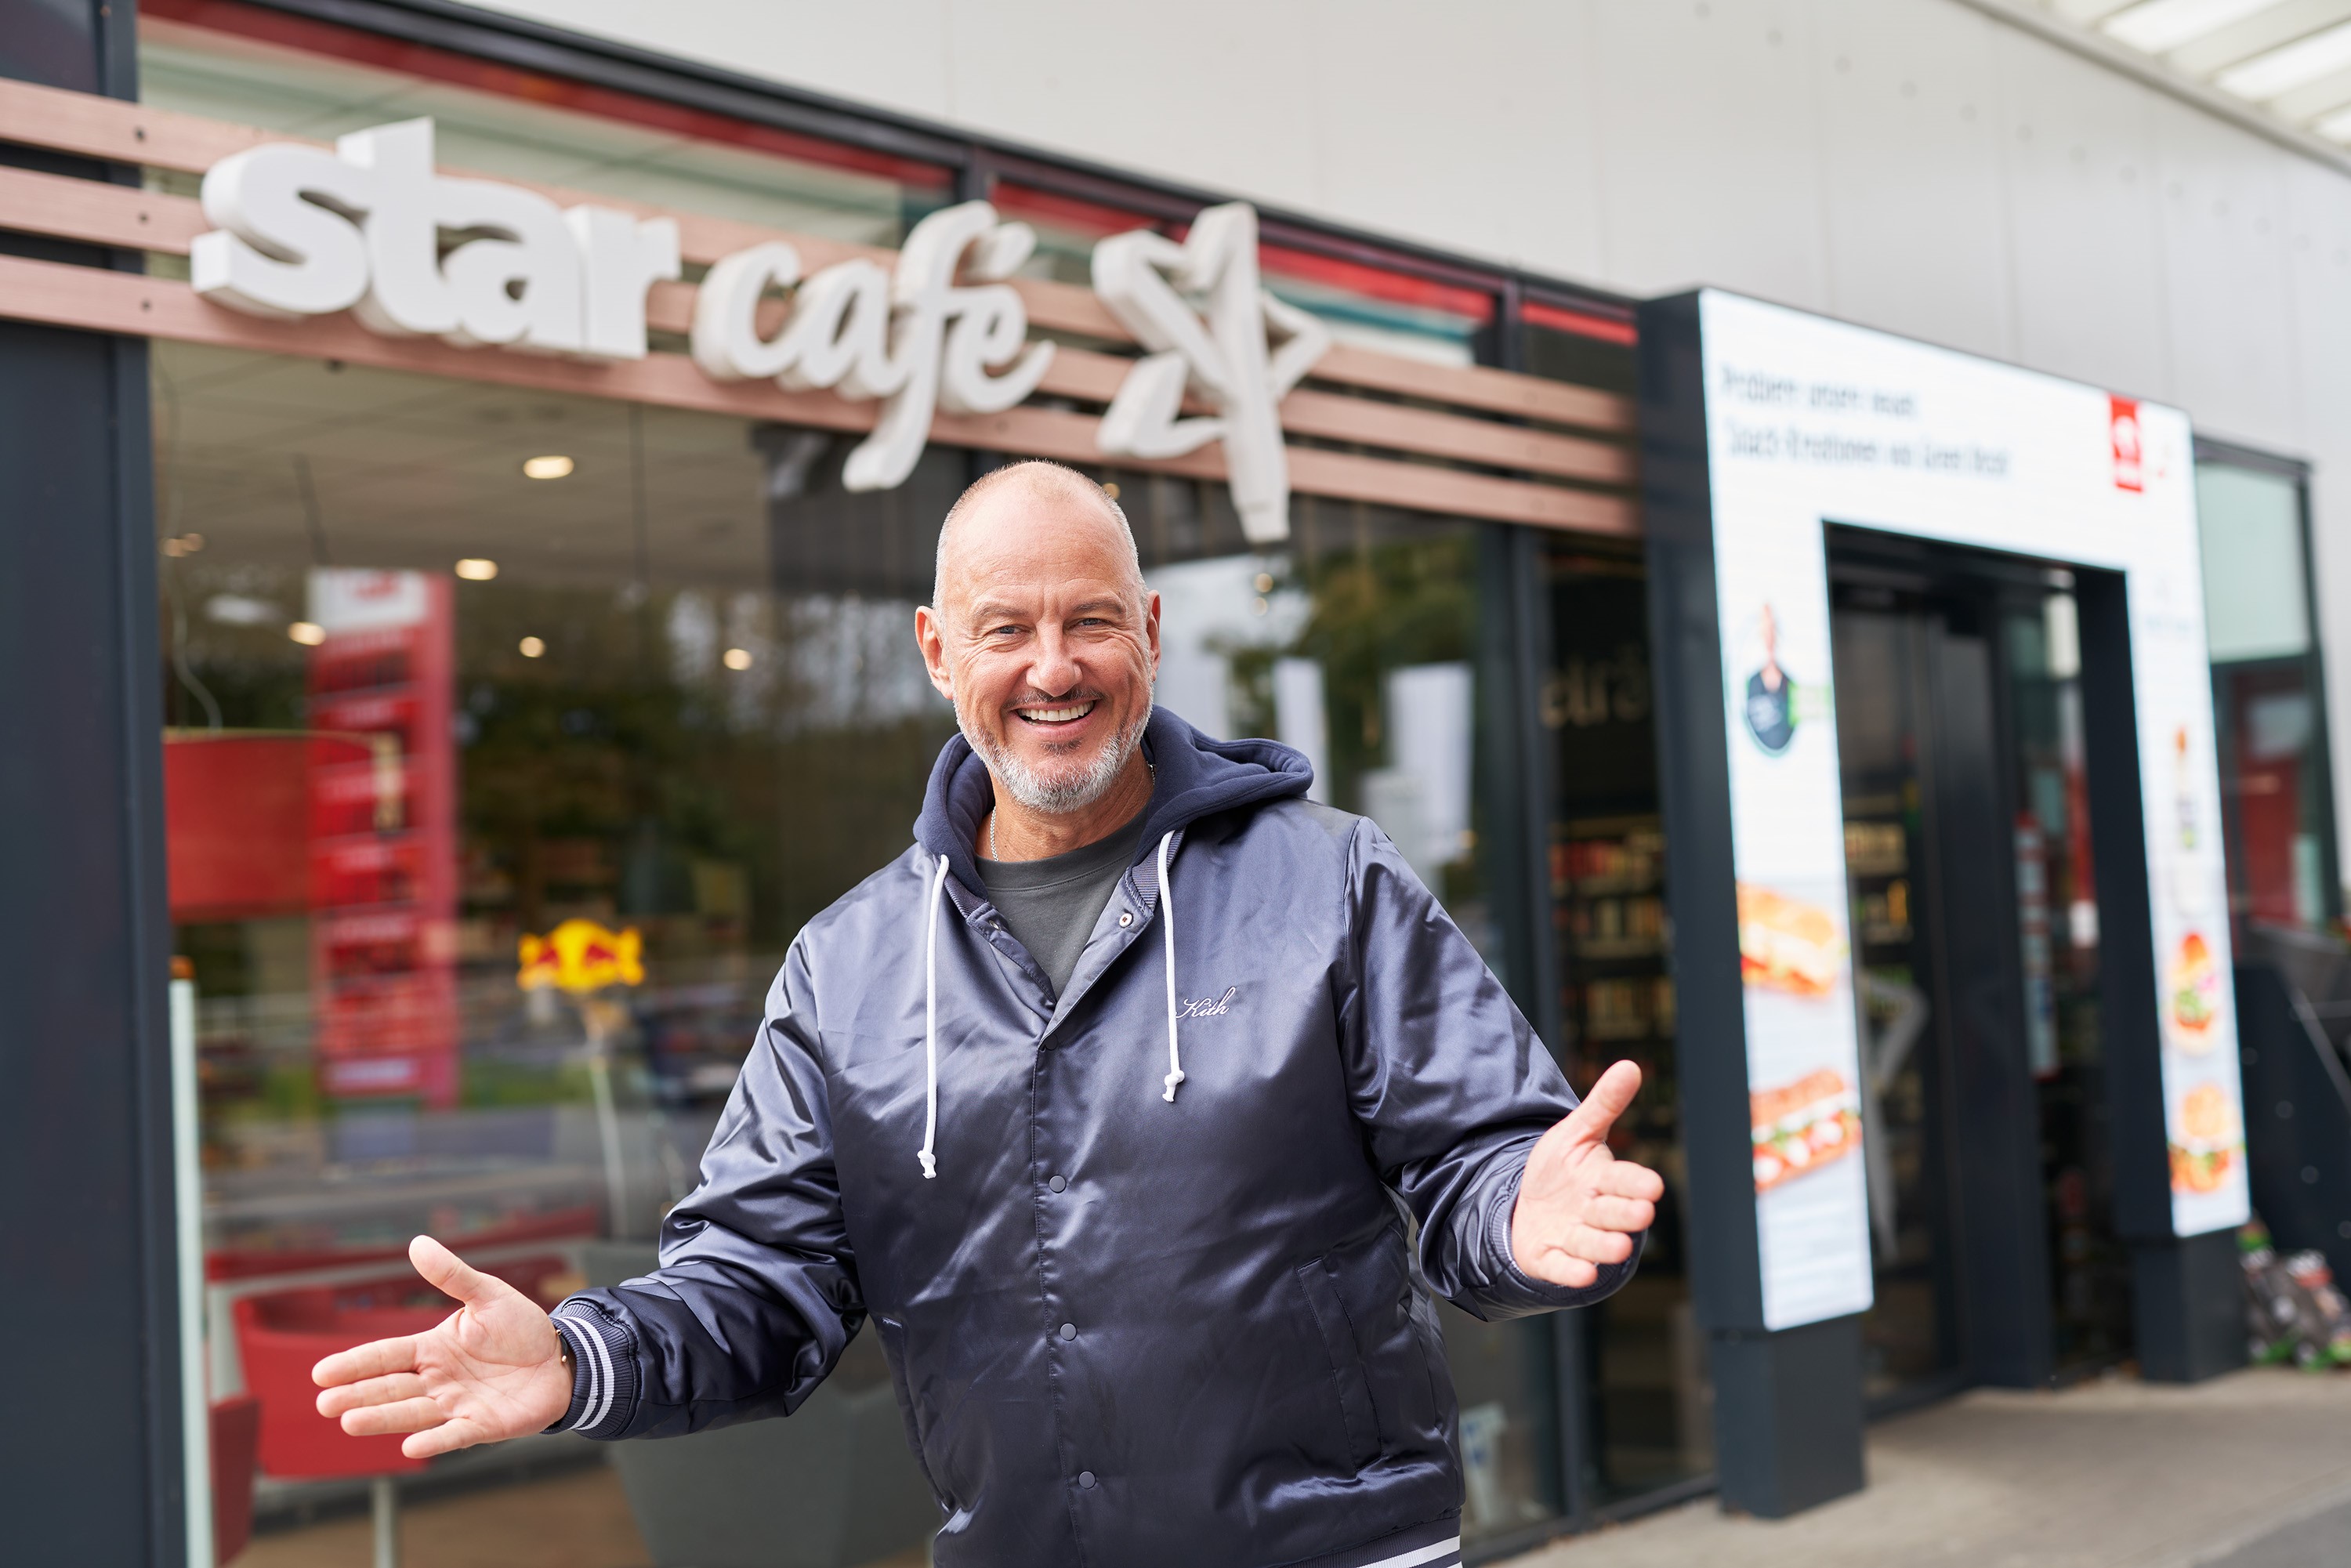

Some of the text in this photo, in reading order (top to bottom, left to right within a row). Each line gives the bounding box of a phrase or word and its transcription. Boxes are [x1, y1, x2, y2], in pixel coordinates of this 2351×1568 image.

[190, 115, 1056, 494] star café
[1176, 986, 1236, 1019] Kith
